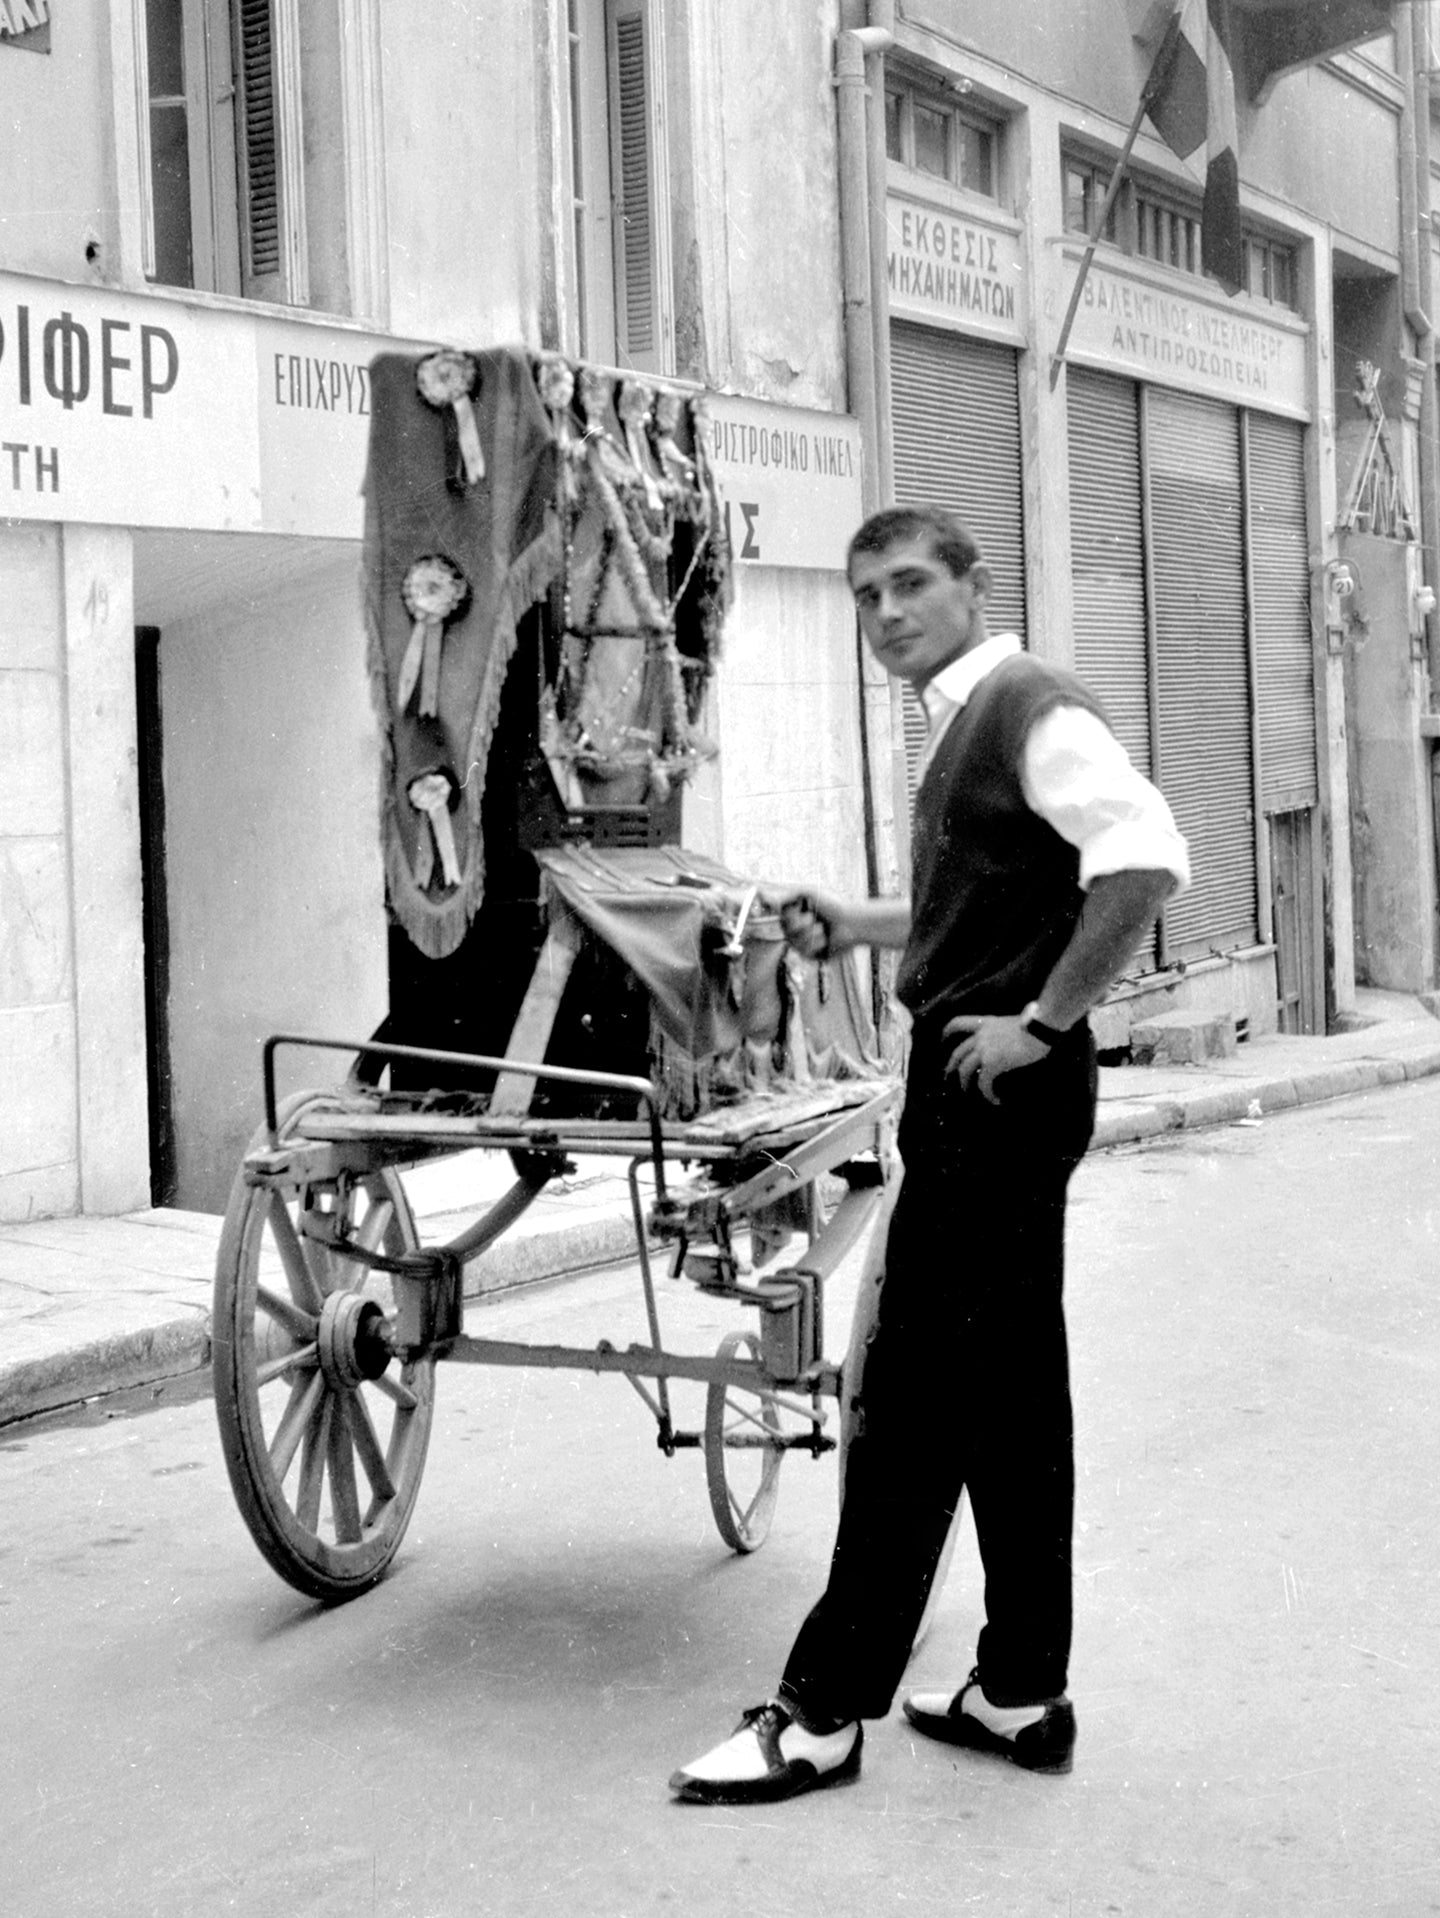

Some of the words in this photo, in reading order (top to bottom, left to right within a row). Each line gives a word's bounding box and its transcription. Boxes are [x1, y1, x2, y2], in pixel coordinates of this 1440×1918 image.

[902, 210, 998, 273] ΕΚΘΕΣΙΣ
[887, 252, 1014, 319] ΜΗΧΑΝΗΜΑΤΩΝ
[0, 304, 179, 419] ΙΦΕΡ
[1112, 325, 1268, 390] ΑΝΤΙΠΡΟΣΩΠΕΙΑΙ
[814, 434, 853, 478] ΝΙΚΕΛ
